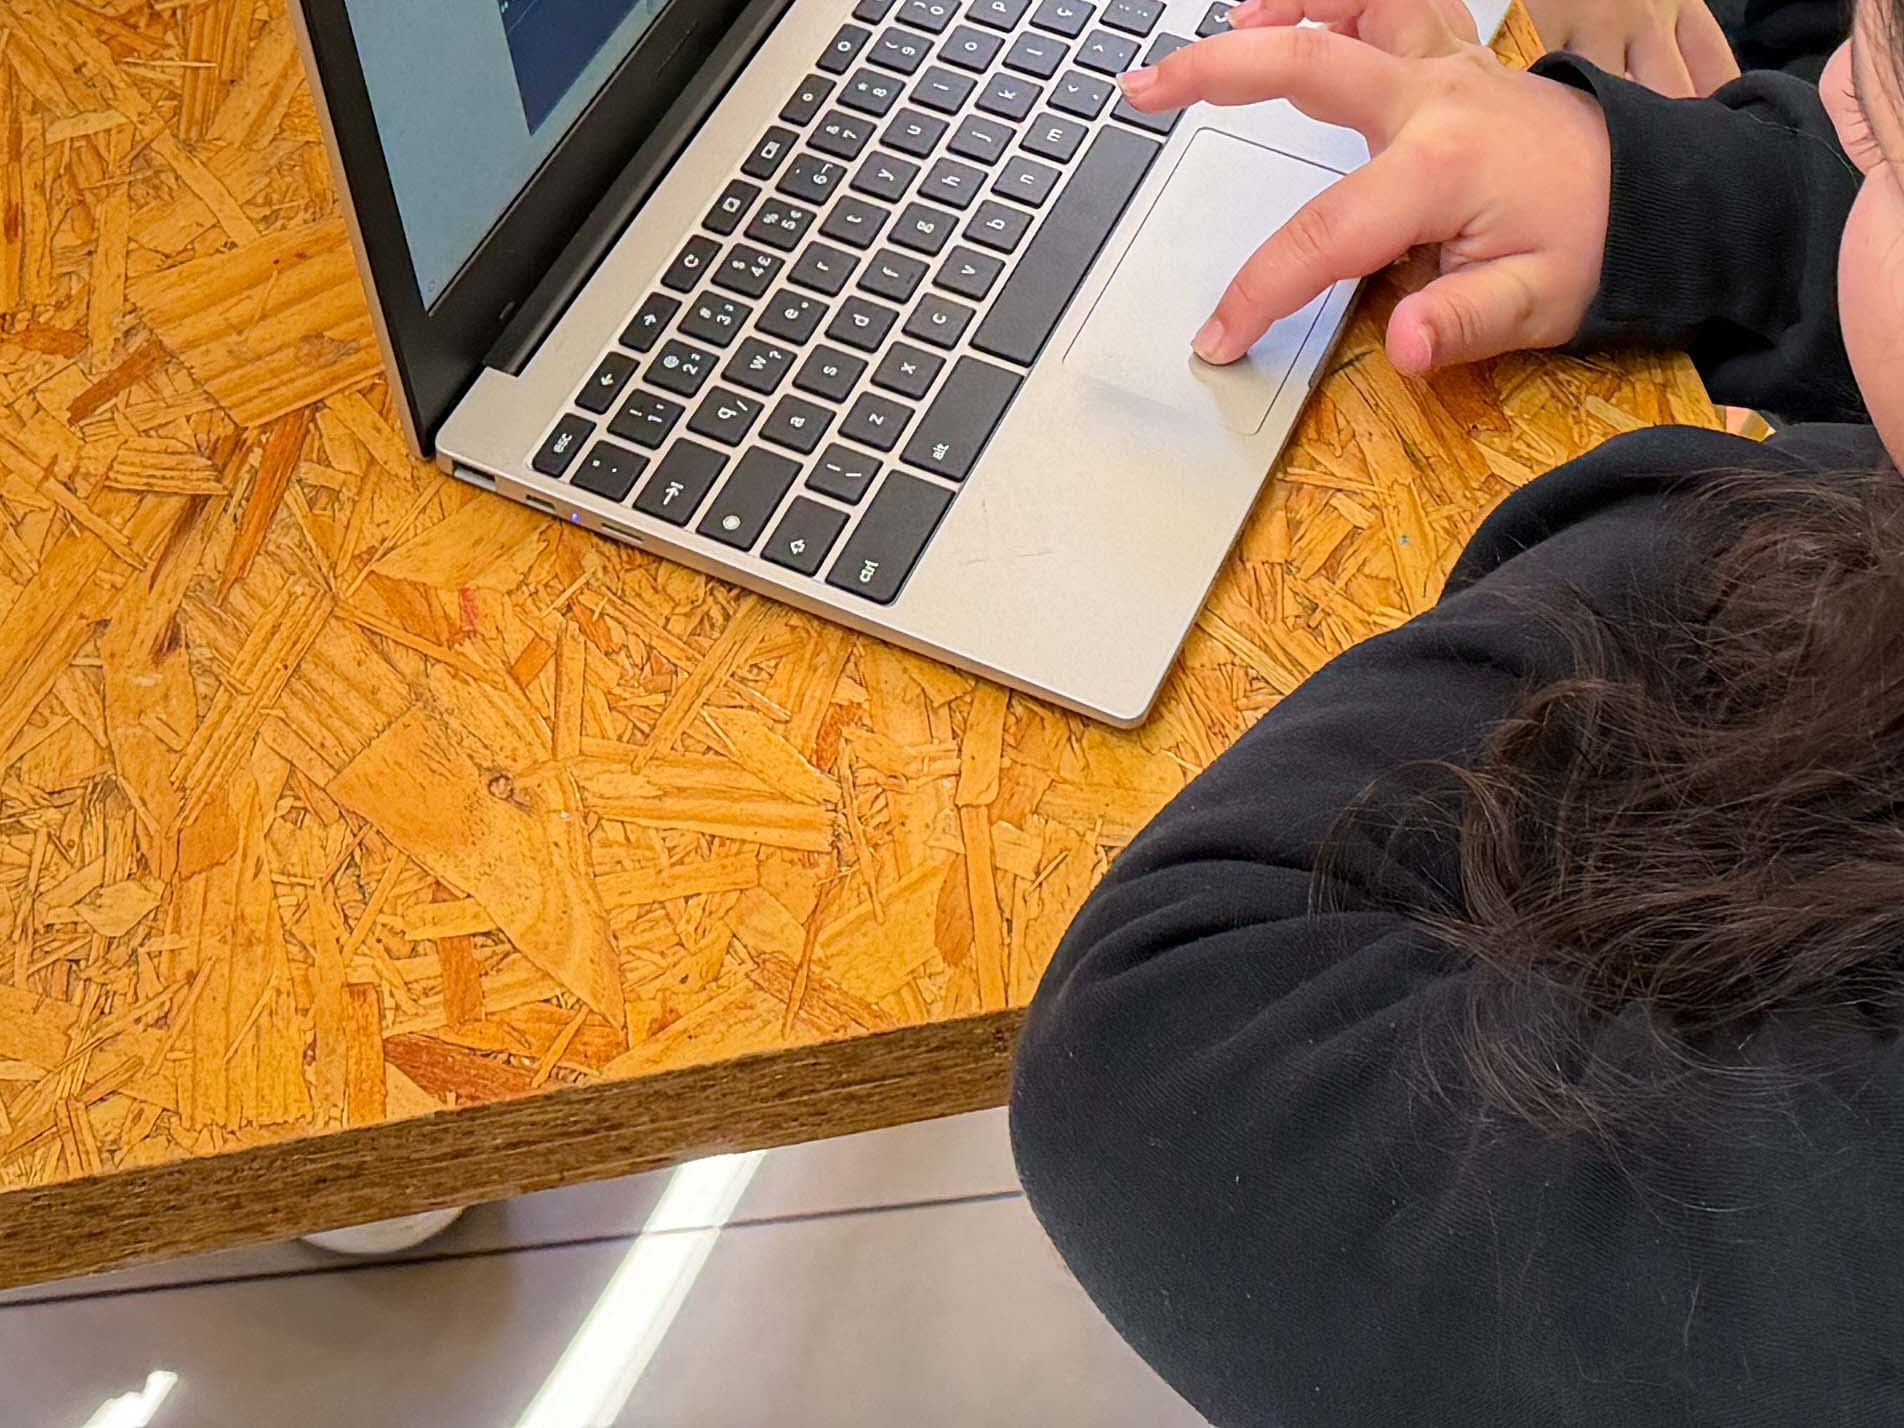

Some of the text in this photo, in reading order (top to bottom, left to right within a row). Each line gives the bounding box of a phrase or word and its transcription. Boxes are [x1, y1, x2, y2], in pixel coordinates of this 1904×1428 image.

[872, 87, 888, 97] 8
[997, 89, 1016, 100] k
[907, 124, 922, 135] u
[1046, 128, 1063, 142] m
[812, 174, 828, 185] 6
[877, 168, 894, 182] y
[941, 175, 961, 187] h
[1019, 174, 1035, 185] n
[780, 219, 796, 230] 5
[916, 220, 935, 234] g
[986, 219, 1006, 230] b
[751, 266, 765, 277] 4
[961, 264, 976, 274] v
[716, 314, 732, 326] 3
[784, 308, 799, 320] e
[853, 313, 870, 327] d
[932, 313, 947, 324] c
[682, 363, 699, 375] 2
[823, 365, 838, 376] s
[900, 362, 916, 375] x
[717, 407, 738, 419] q
[868, 413, 884, 425] z
[790, 416, 806, 428] a
[553, 433, 573, 454] esc
[931, 442, 950, 461] alt
[859, 559, 880, 583] ctrl
